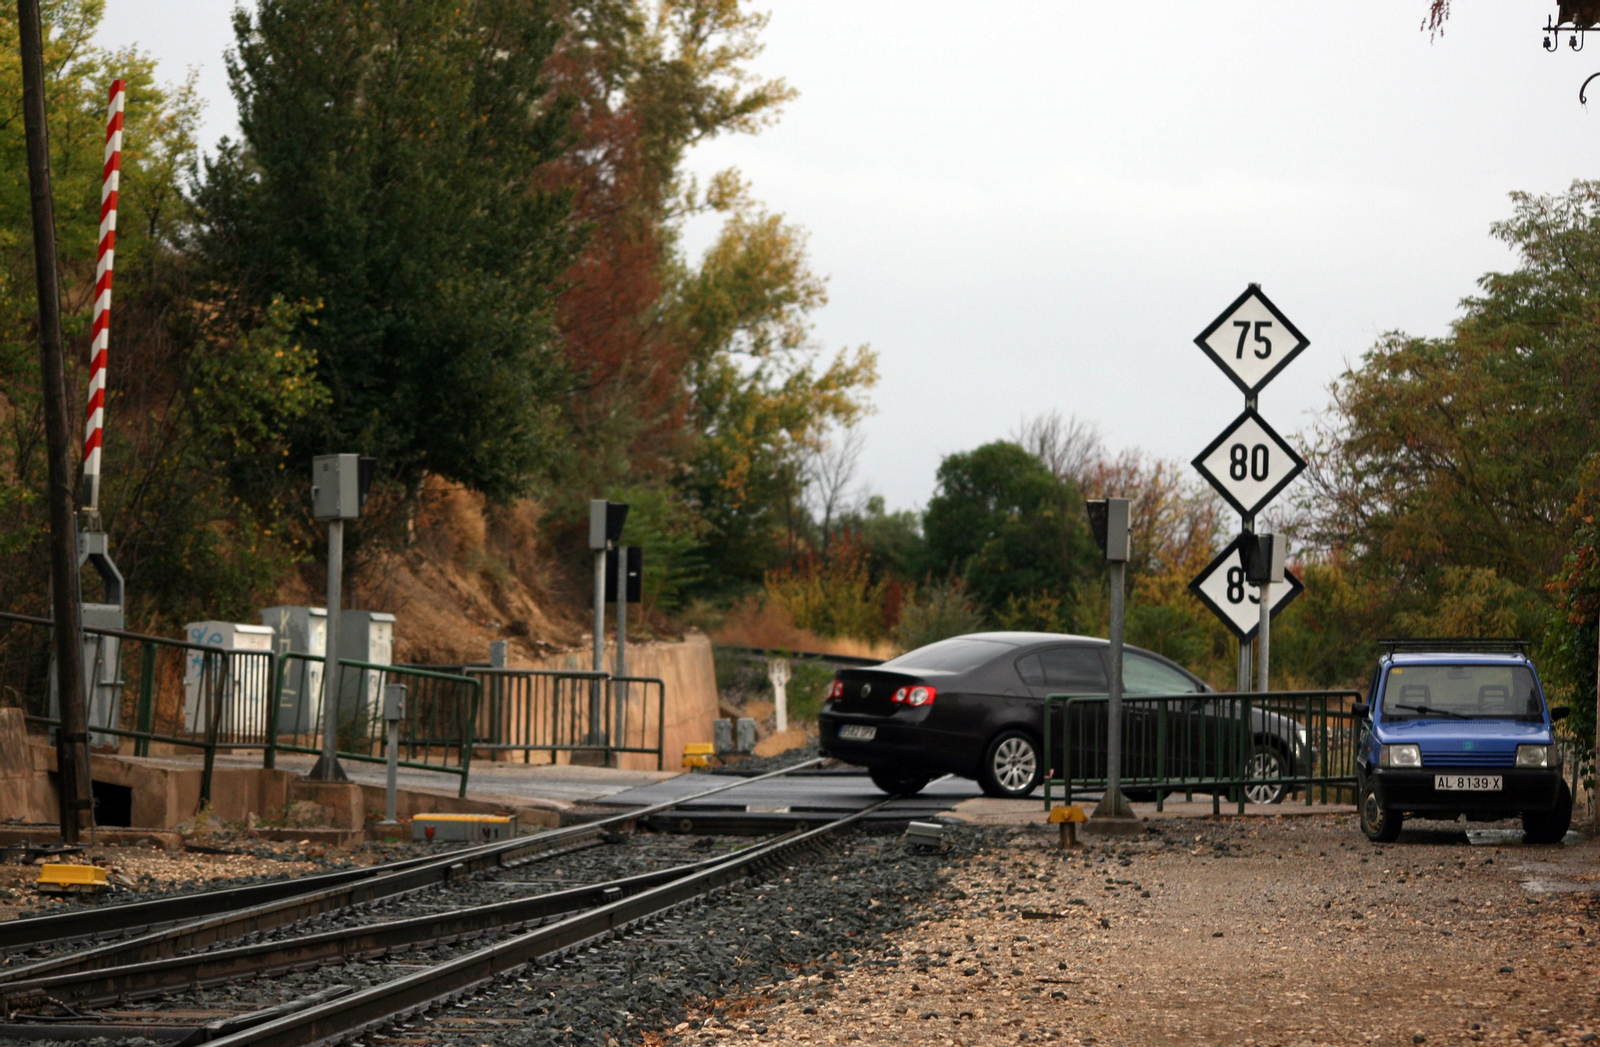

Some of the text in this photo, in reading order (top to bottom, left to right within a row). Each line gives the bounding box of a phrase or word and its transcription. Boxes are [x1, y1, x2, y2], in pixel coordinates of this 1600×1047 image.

[1233, 321, 1272, 359] 75
[1230, 443, 1269, 482] 80
[1438, 777, 1453, 789] AL
[1457, 777, 1489, 789] 8139
